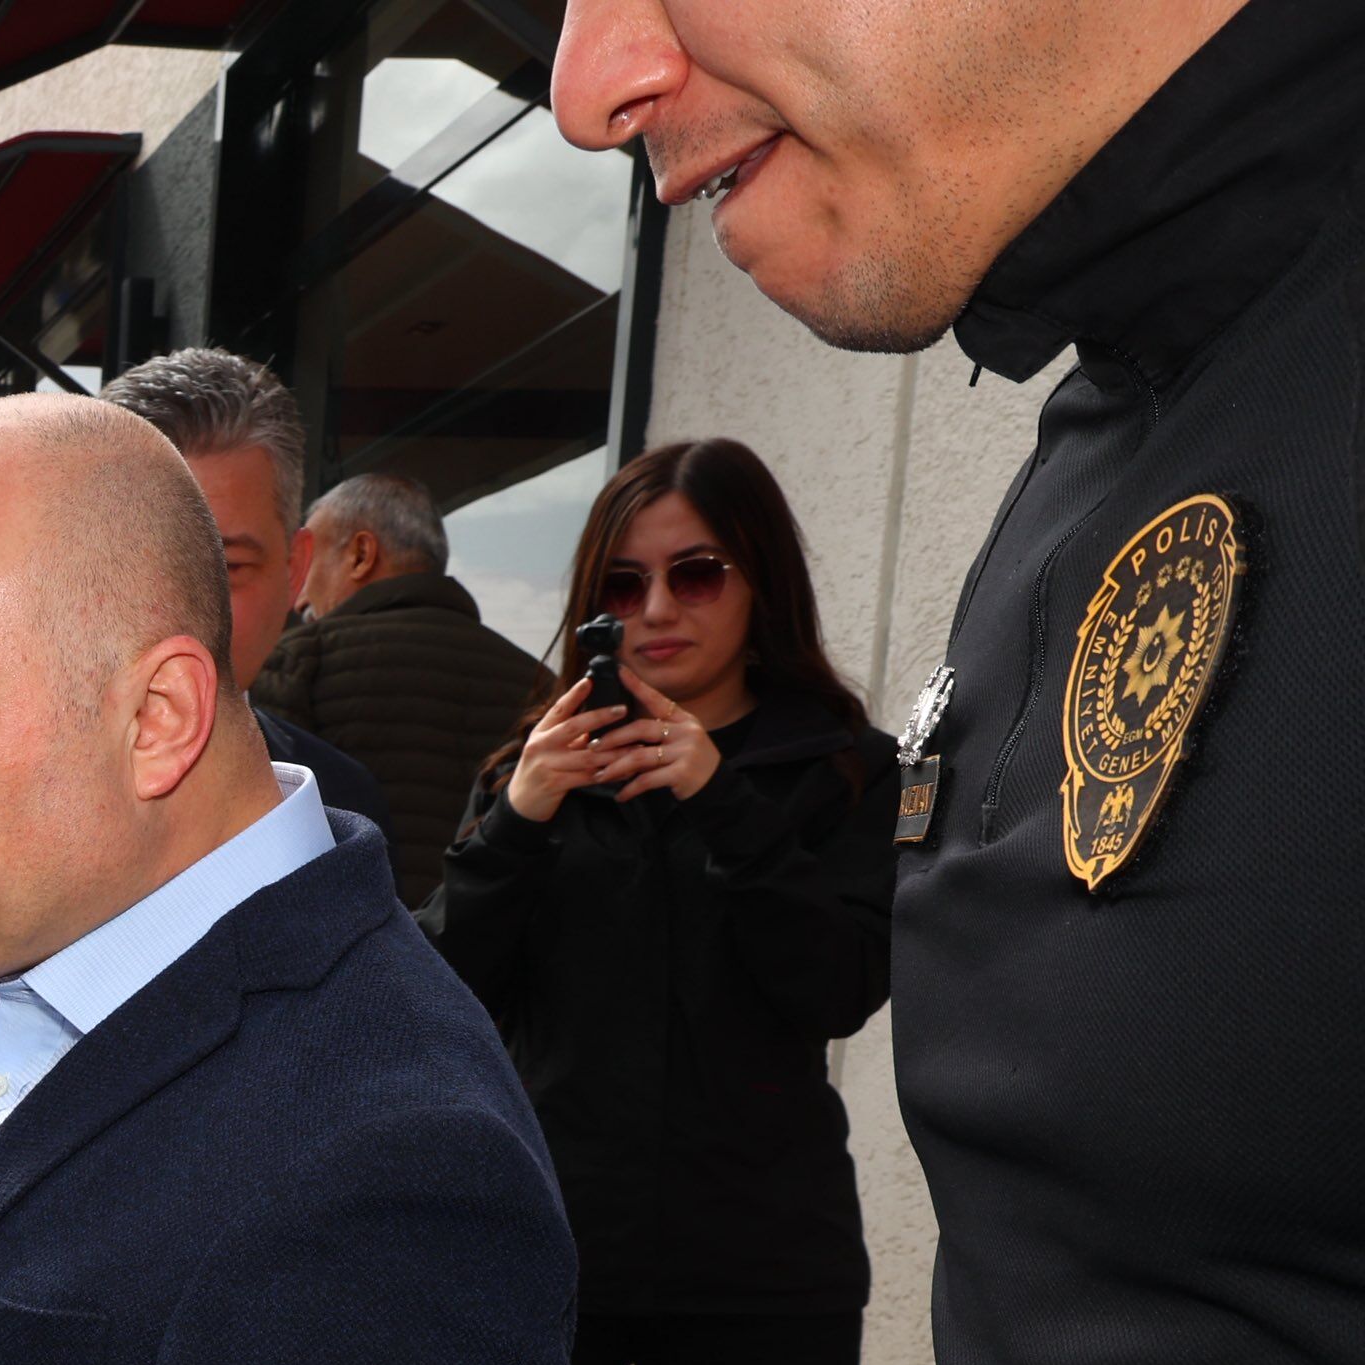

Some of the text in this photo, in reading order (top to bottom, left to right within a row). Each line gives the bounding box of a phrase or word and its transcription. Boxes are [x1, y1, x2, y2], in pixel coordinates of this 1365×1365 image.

[1131, 508, 1218, 575] POLİS
[1080, 610, 1116, 754] EMNİYET
[1122, 729, 1144, 745] EGM
[1098, 749, 1153, 773] GENEL
[1090, 835, 1123, 855] 1845
